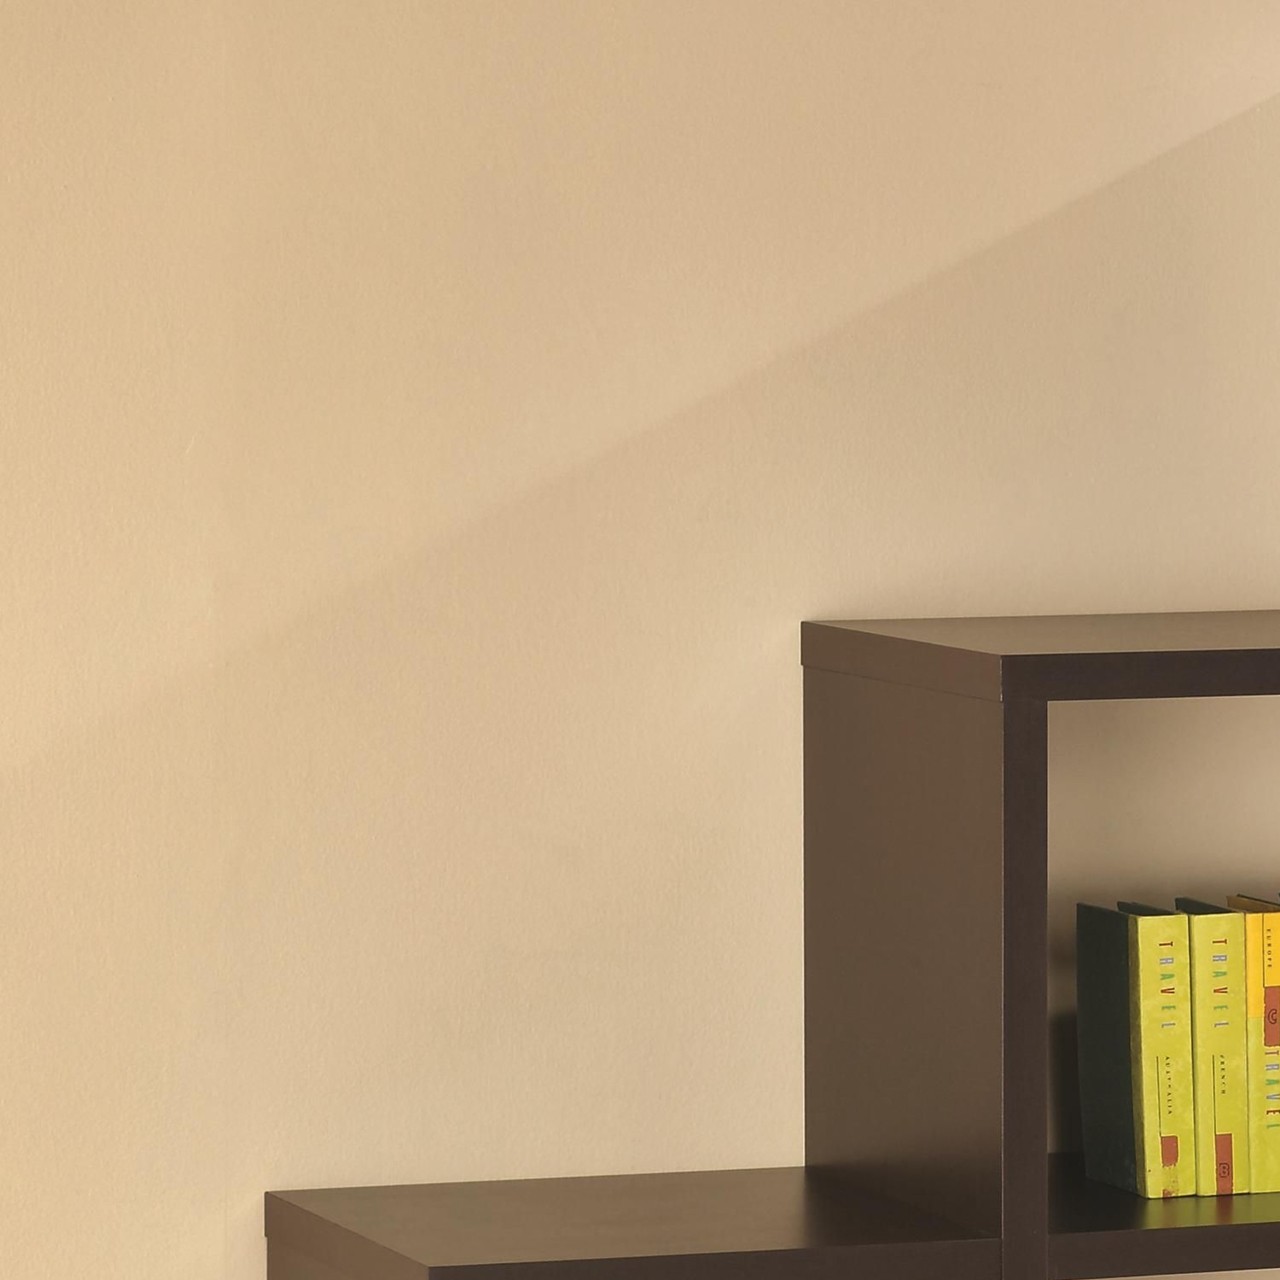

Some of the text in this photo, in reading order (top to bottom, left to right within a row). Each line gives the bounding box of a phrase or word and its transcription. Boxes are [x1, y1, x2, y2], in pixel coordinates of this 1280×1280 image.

[1158, 941, 1177, 1028] TRAVEL
[1212, 938, 1229, 1028] TRAVEL
[1264, 1050, 1280, 1129] TRAVEL
